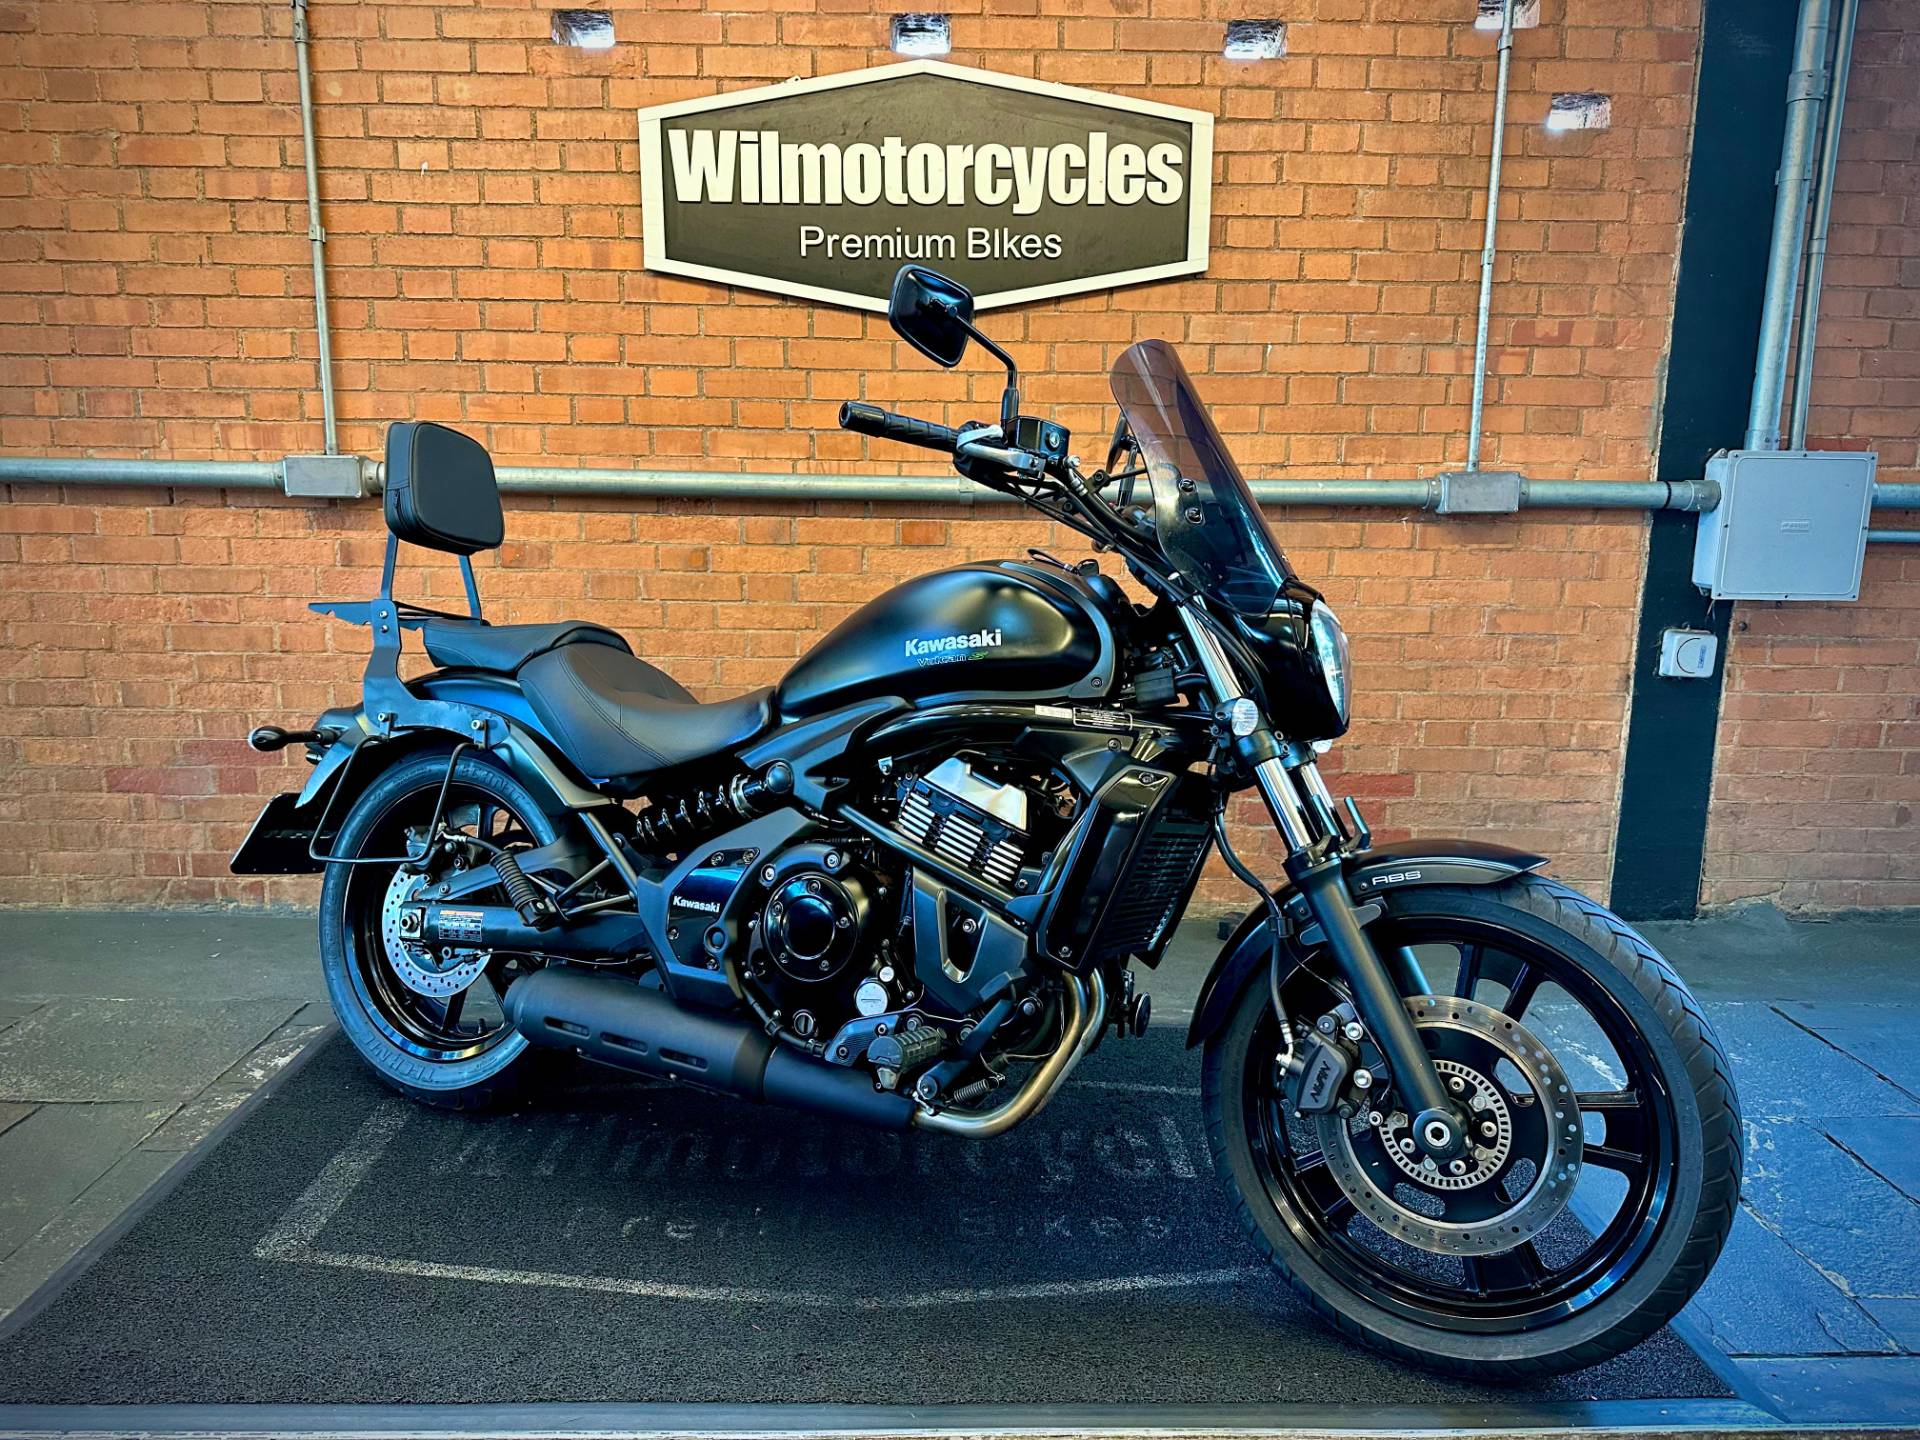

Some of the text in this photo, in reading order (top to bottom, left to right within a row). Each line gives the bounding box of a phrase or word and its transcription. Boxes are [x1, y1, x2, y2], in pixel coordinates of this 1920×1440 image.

[667, 129, 1184, 216] Wilmotorcycles
[799, 225, 956, 259] Premium
[905, 628, 1002, 657] Kawasaki
[916, 653, 967, 667] Vulcan
[1372, 870, 1421, 886] ABS
[673, 895, 721, 913] Kawasaki
